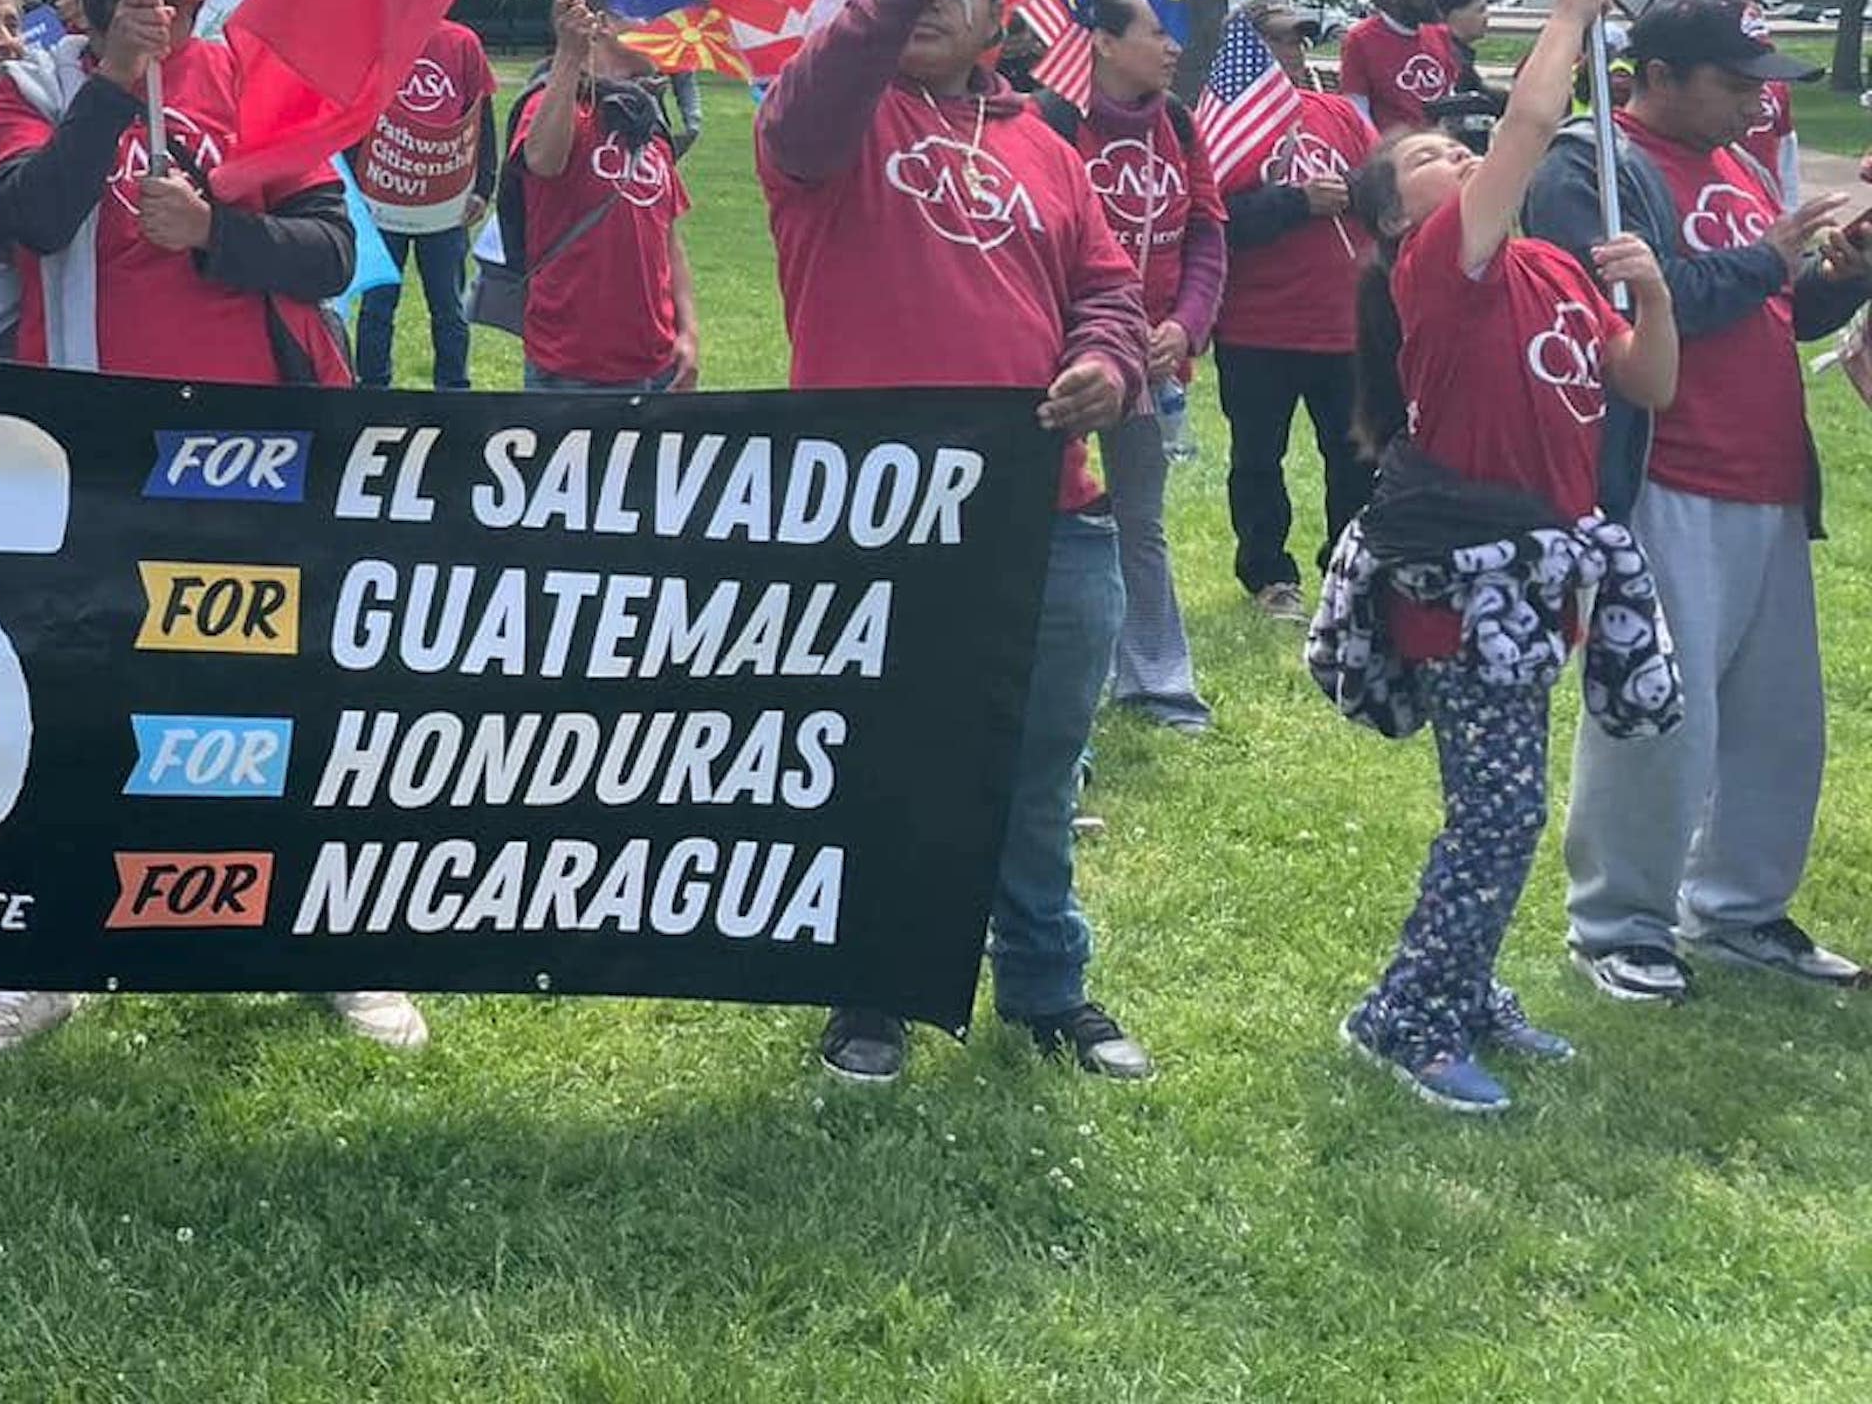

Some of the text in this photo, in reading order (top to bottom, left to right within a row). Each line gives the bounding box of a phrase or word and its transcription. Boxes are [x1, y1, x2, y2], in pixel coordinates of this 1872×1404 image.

[886, 151, 1045, 233] CASA
[166, 426, 986, 548] FOR EL SALVADOR
[160, 559, 894, 679] FOR GUATEMALA
[148, 709, 848, 809] FOR HONDURAS
[132, 839, 845, 945] FOR NICARAGUA
